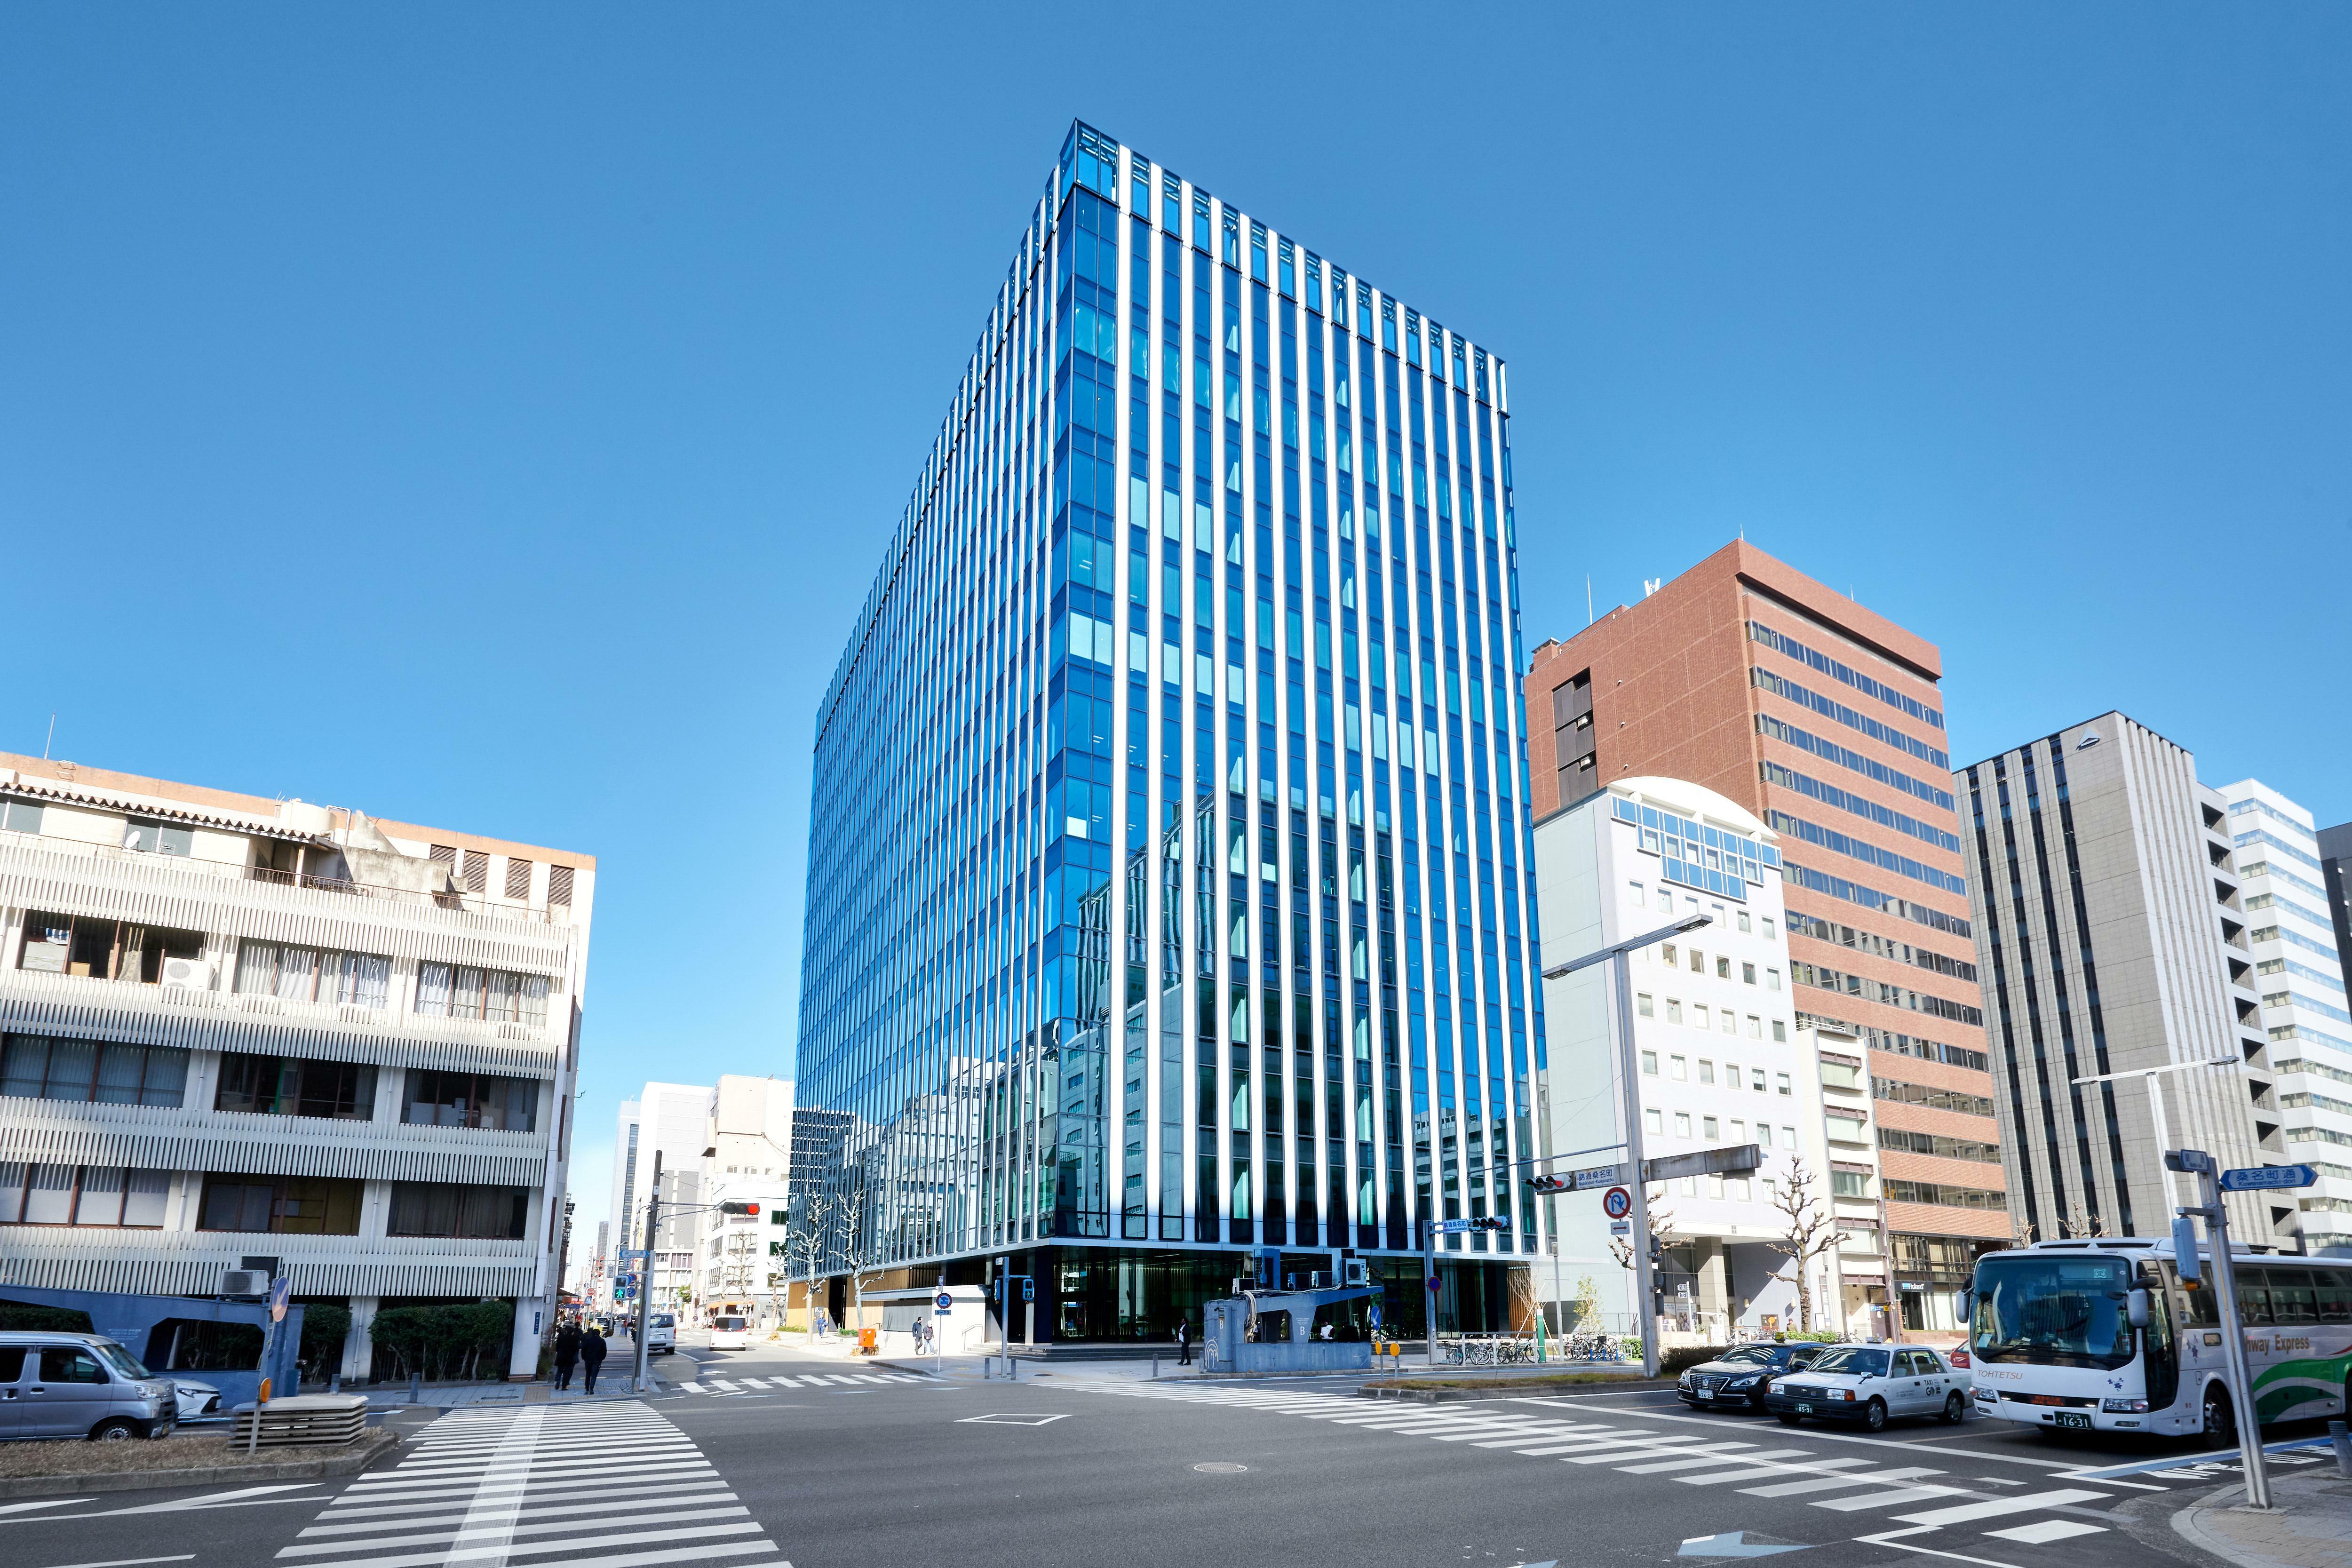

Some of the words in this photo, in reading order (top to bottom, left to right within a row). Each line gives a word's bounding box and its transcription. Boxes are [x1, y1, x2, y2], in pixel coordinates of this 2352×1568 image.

[1578, 1169, 1613, 1181] 錦通桑名町
[2236, 1169, 2296, 1182] 桑名町通
[1220, 1320, 1224, 1329] B
[1300, 1326, 1305, 1336] B
[2245, 1335, 2270, 1356] hway
[2275, 1334, 2310, 1354] Express
[1977, 1369, 2023, 1380] TOHTETSU
[2063, 1417, 2088, 1427] 16-31
